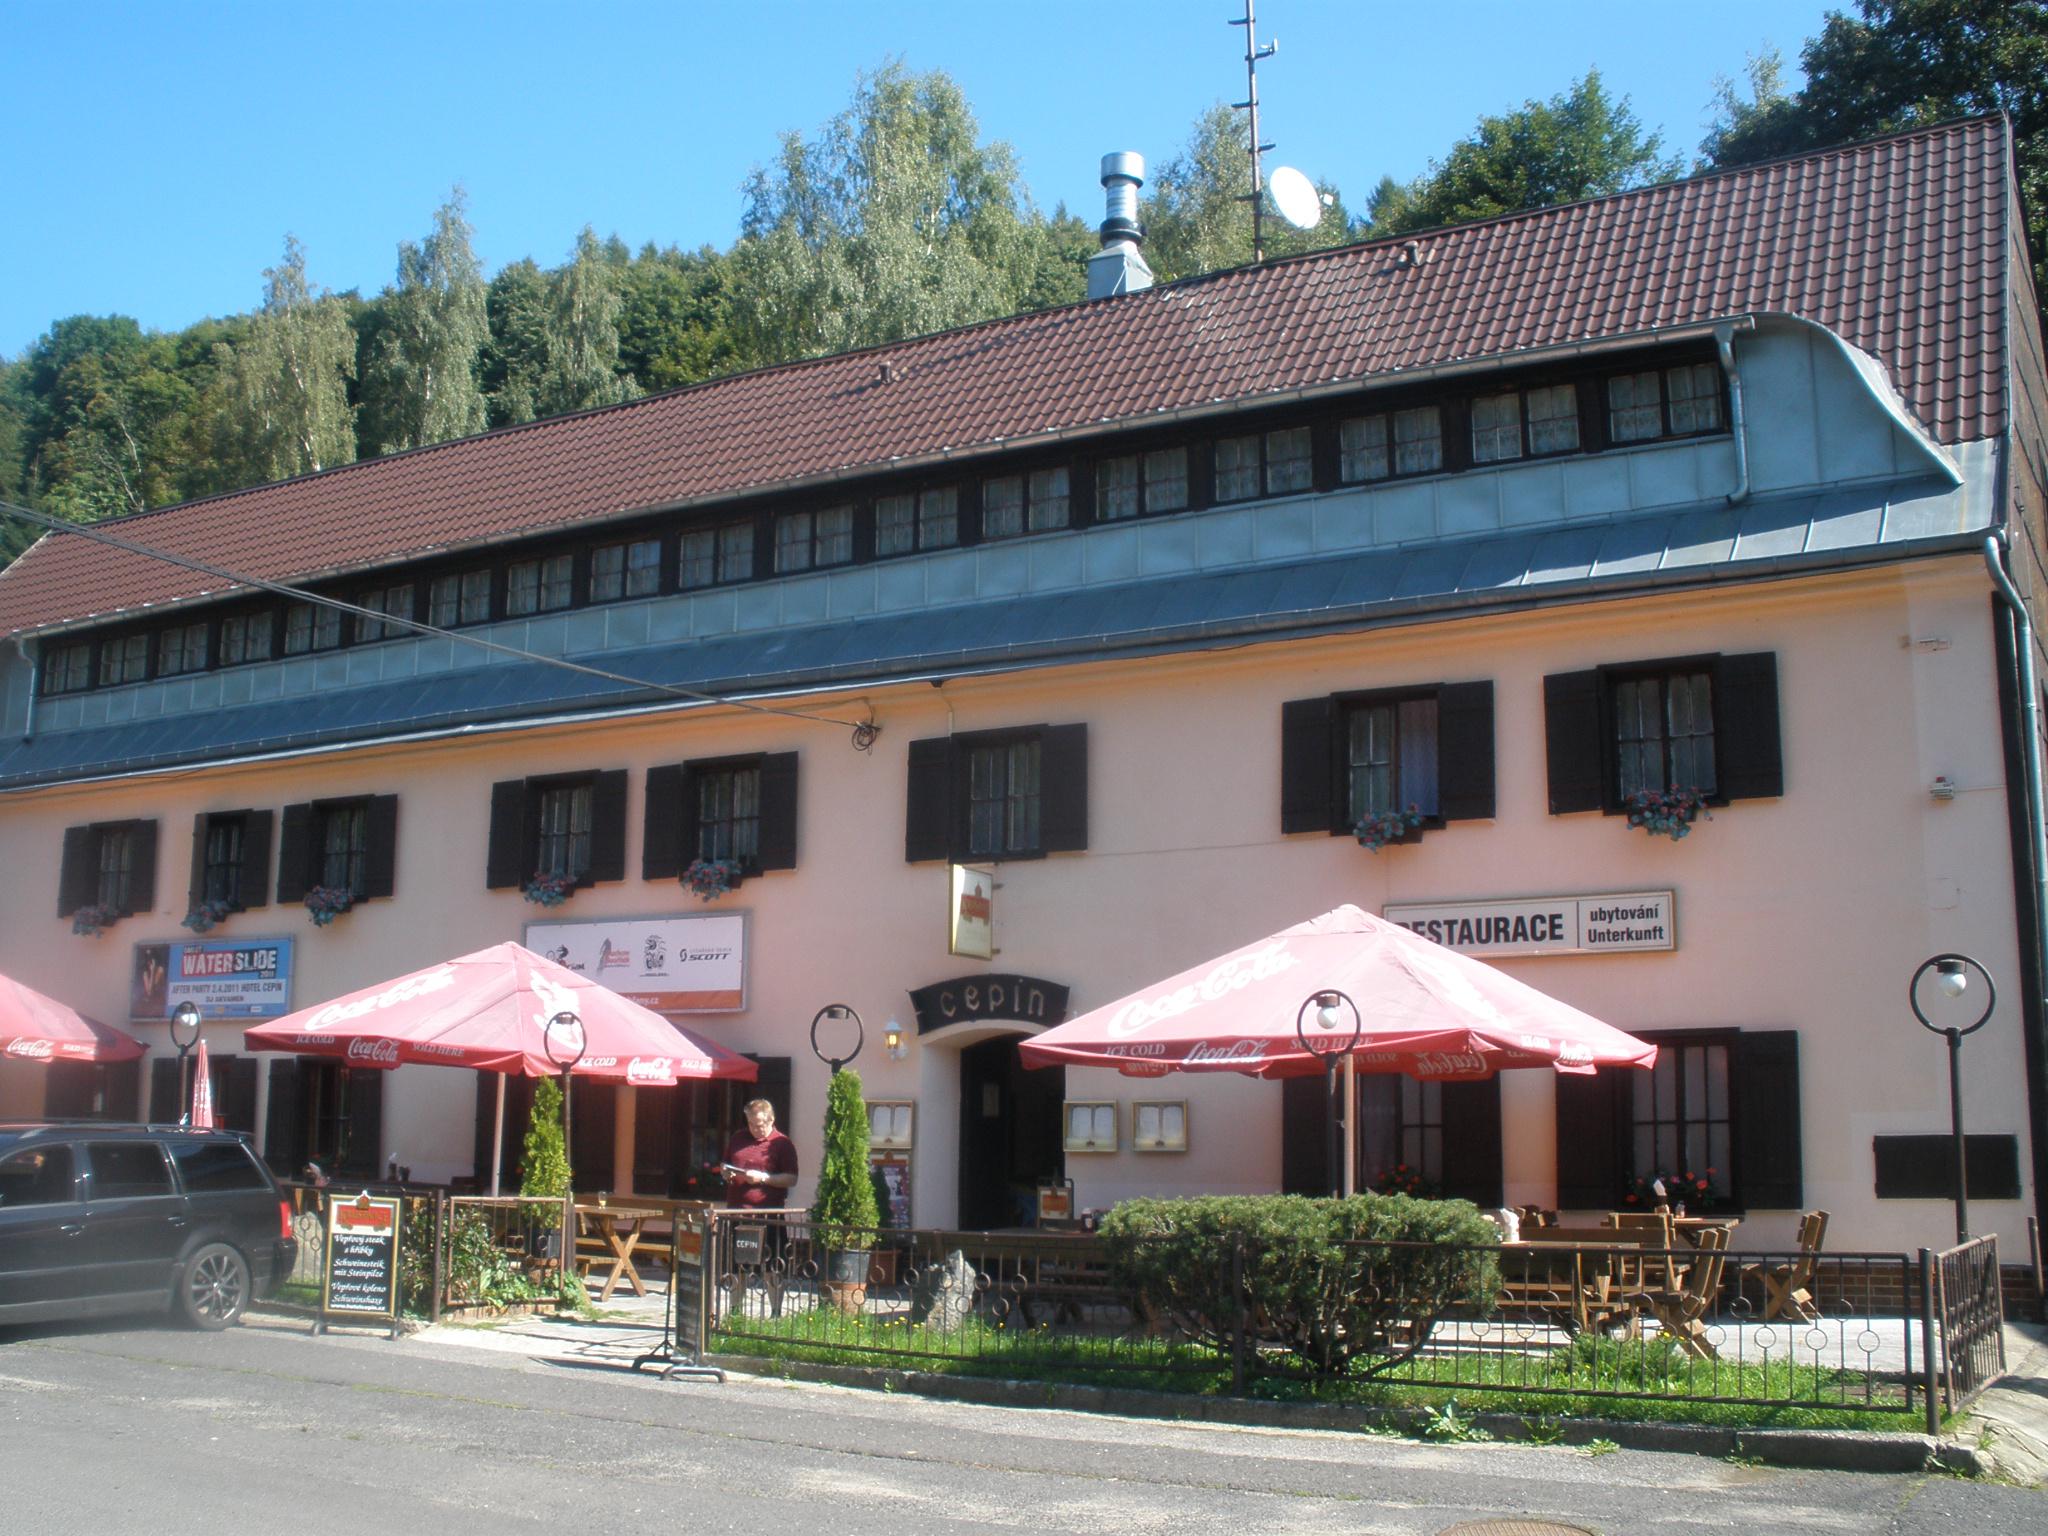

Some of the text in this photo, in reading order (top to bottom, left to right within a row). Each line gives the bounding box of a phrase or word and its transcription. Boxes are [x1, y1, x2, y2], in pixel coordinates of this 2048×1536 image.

[1590, 903, 1659, 924] ubytování
[1588, 926, 1664, 943] Unterkunft
[688, 953, 731, 961] SCOTT
[192, 984, 211, 993] PARTY
[240, 982, 261, 992] HOTEL
[313, 1035, 335, 1045] COLD
[437, 1043, 465, 1057] HERE
[1130, 1043, 1166, 1056] COLD
[593, 1057, 617, 1066] COLD
